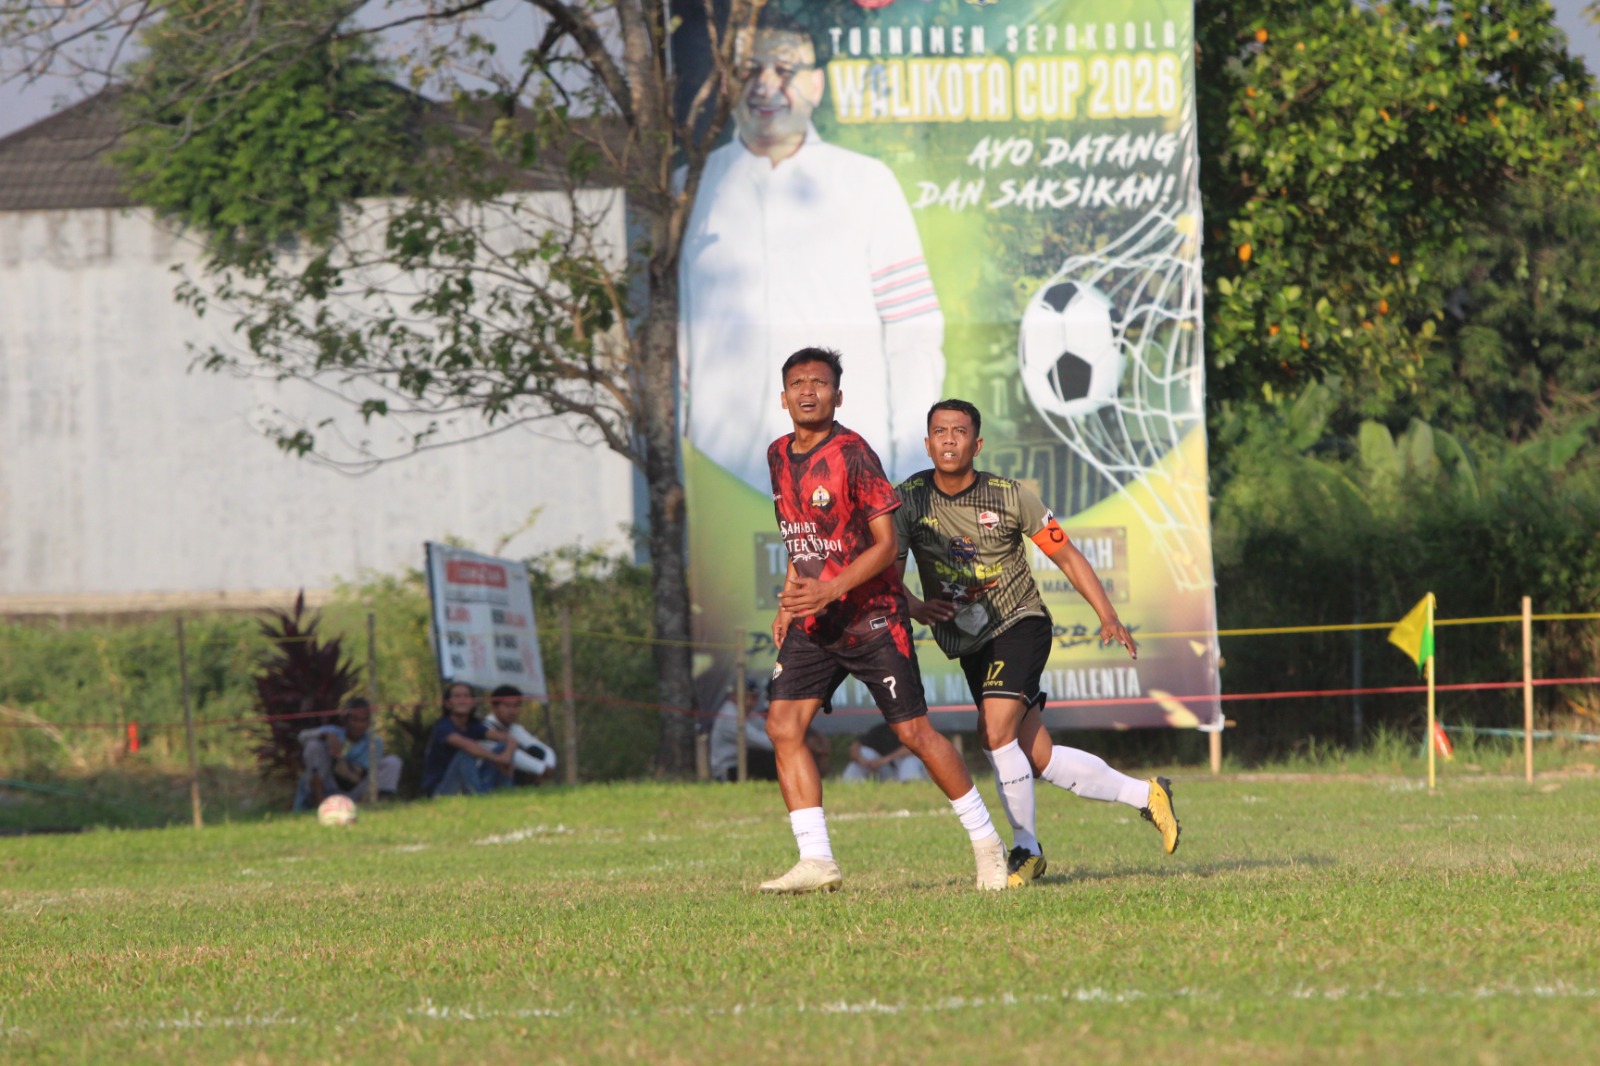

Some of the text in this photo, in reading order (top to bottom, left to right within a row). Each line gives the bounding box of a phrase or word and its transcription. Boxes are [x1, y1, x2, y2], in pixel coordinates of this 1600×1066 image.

[829, 20, 1175, 55] TURNAMEN SEPAKBOLA
[832, 55, 1178, 118] WALIKOTA CUP 2026
[967, 130, 1180, 170] AYO DATANG
[913, 173, 1176, 211] DAN SAKSIKAN!
[785, 539, 810, 553] TER
[986, 660, 1005, 680] 17
[1040, 667, 1141, 699] RTALENTA
[882, 675, 897, 699] 7
